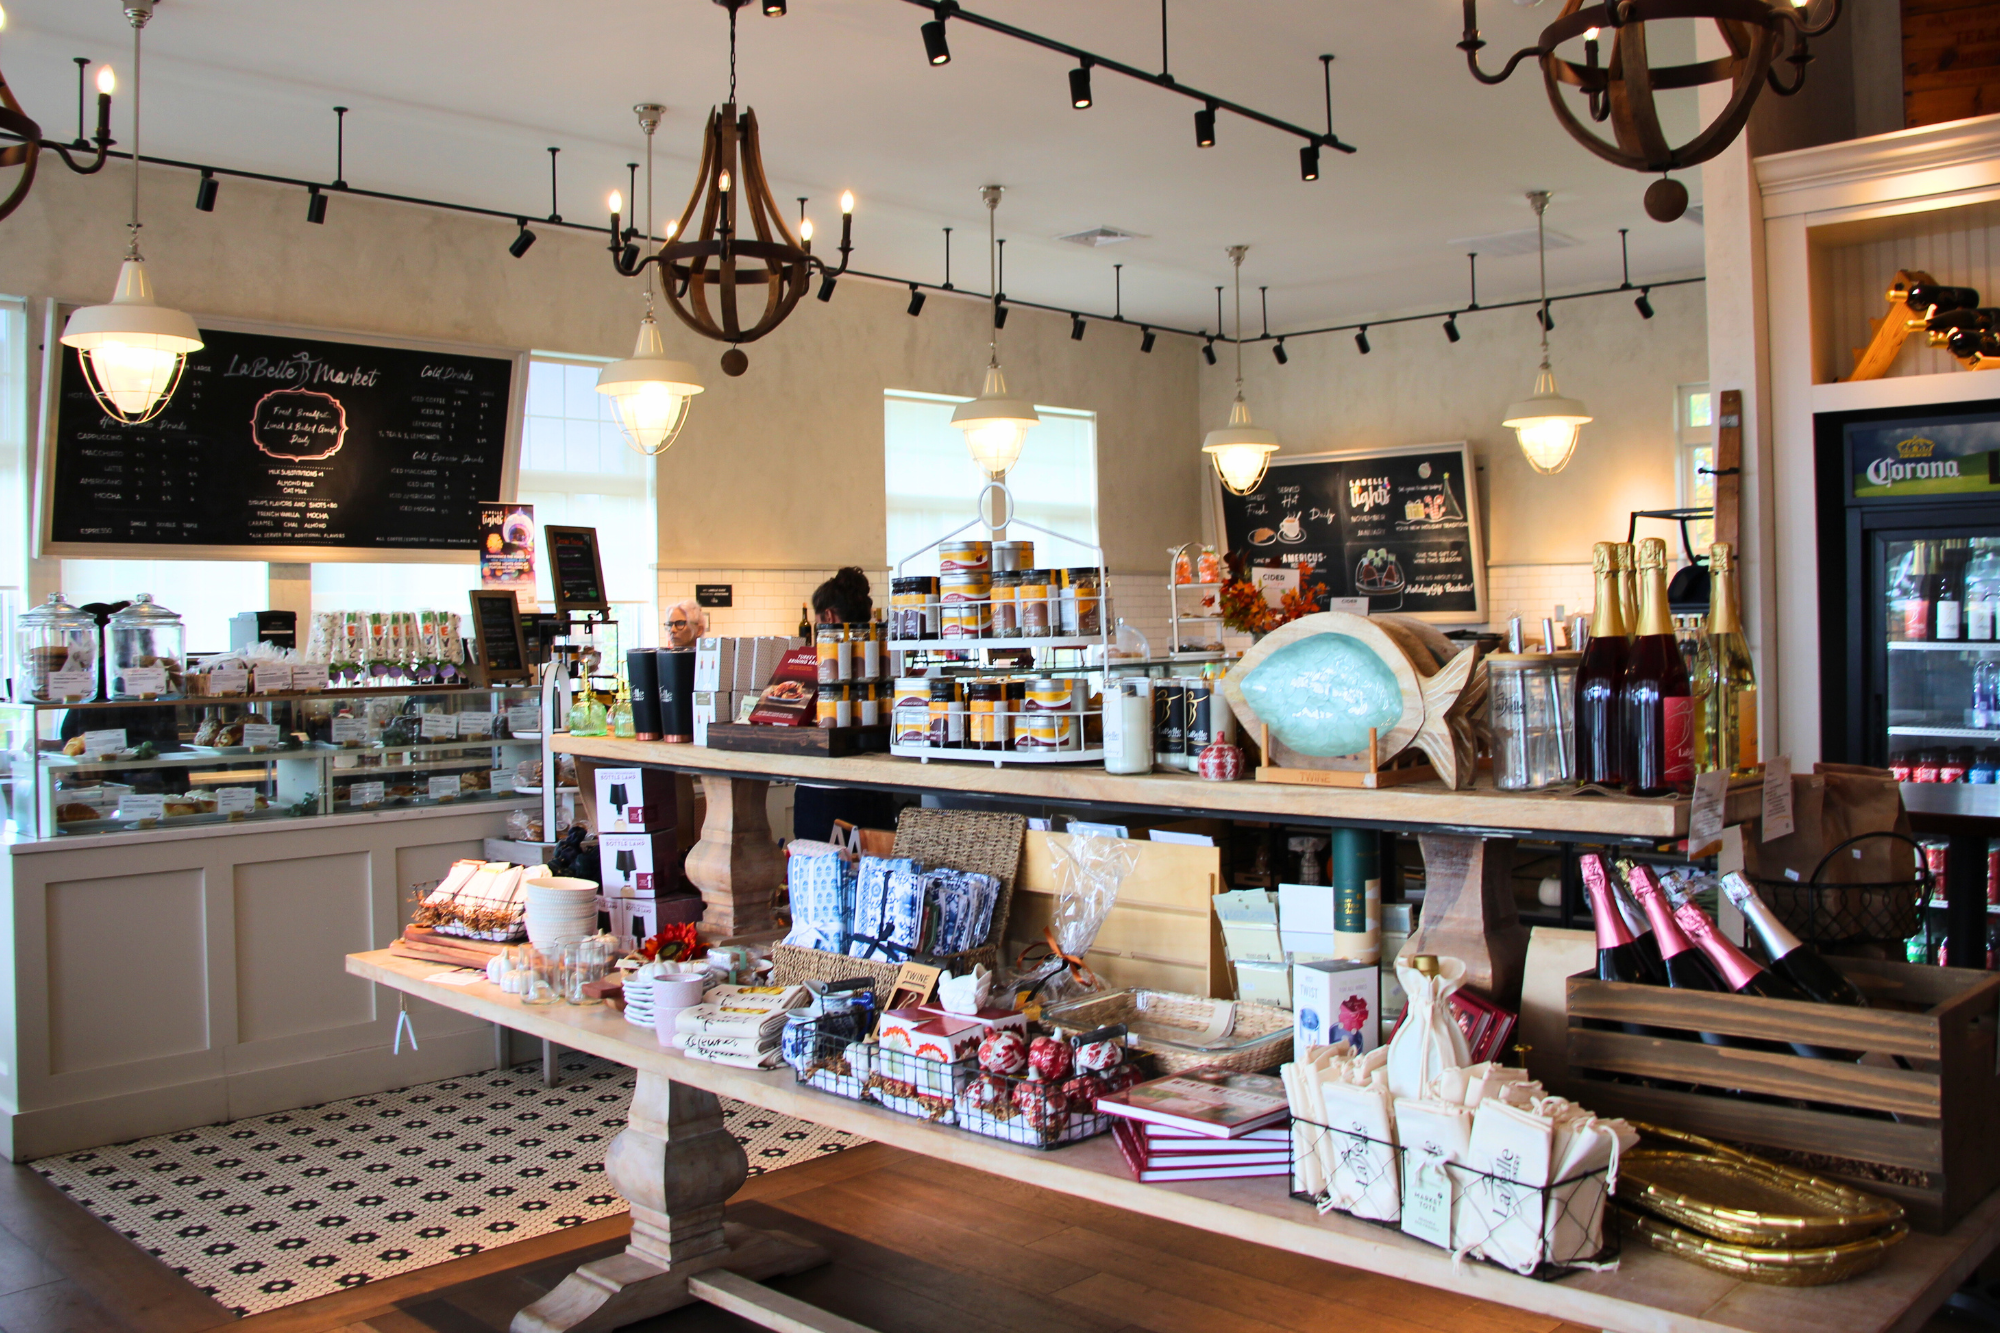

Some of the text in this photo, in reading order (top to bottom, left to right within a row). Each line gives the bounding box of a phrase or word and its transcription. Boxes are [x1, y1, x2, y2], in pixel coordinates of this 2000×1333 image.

[313, 362, 380, 387] Market
[420, 364, 474, 382] Cold Drinks
[77, 432, 123, 441] CAPPUCCINO
[289, 434, 310, 446] Daily
[82, 450, 124, 458] MACCHIATO
[412, 451, 428, 461] Cold
[1866, 456, 1960, 488] Corona
[80, 478, 123, 486] AMERICANO
[1349, 476, 1389, 487] LABELLE
[94, 492, 122, 500] MOCHA
[1281, 494, 1299, 508] Hot
[1350, 486, 1391, 512] lights
[482, 514, 504, 527] lights
[1309, 507, 1336, 525] Daily
[1351, 514, 1386, 523] NOVEMBER
[1404, 584, 1431, 596] Holiday
[1300, 772, 1330, 783] TWINE
[905, 970, 930, 984] TWINE
[1415, 1191, 1441, 1206] MARKET
[1420, 1201, 1436, 1212] TOTE
